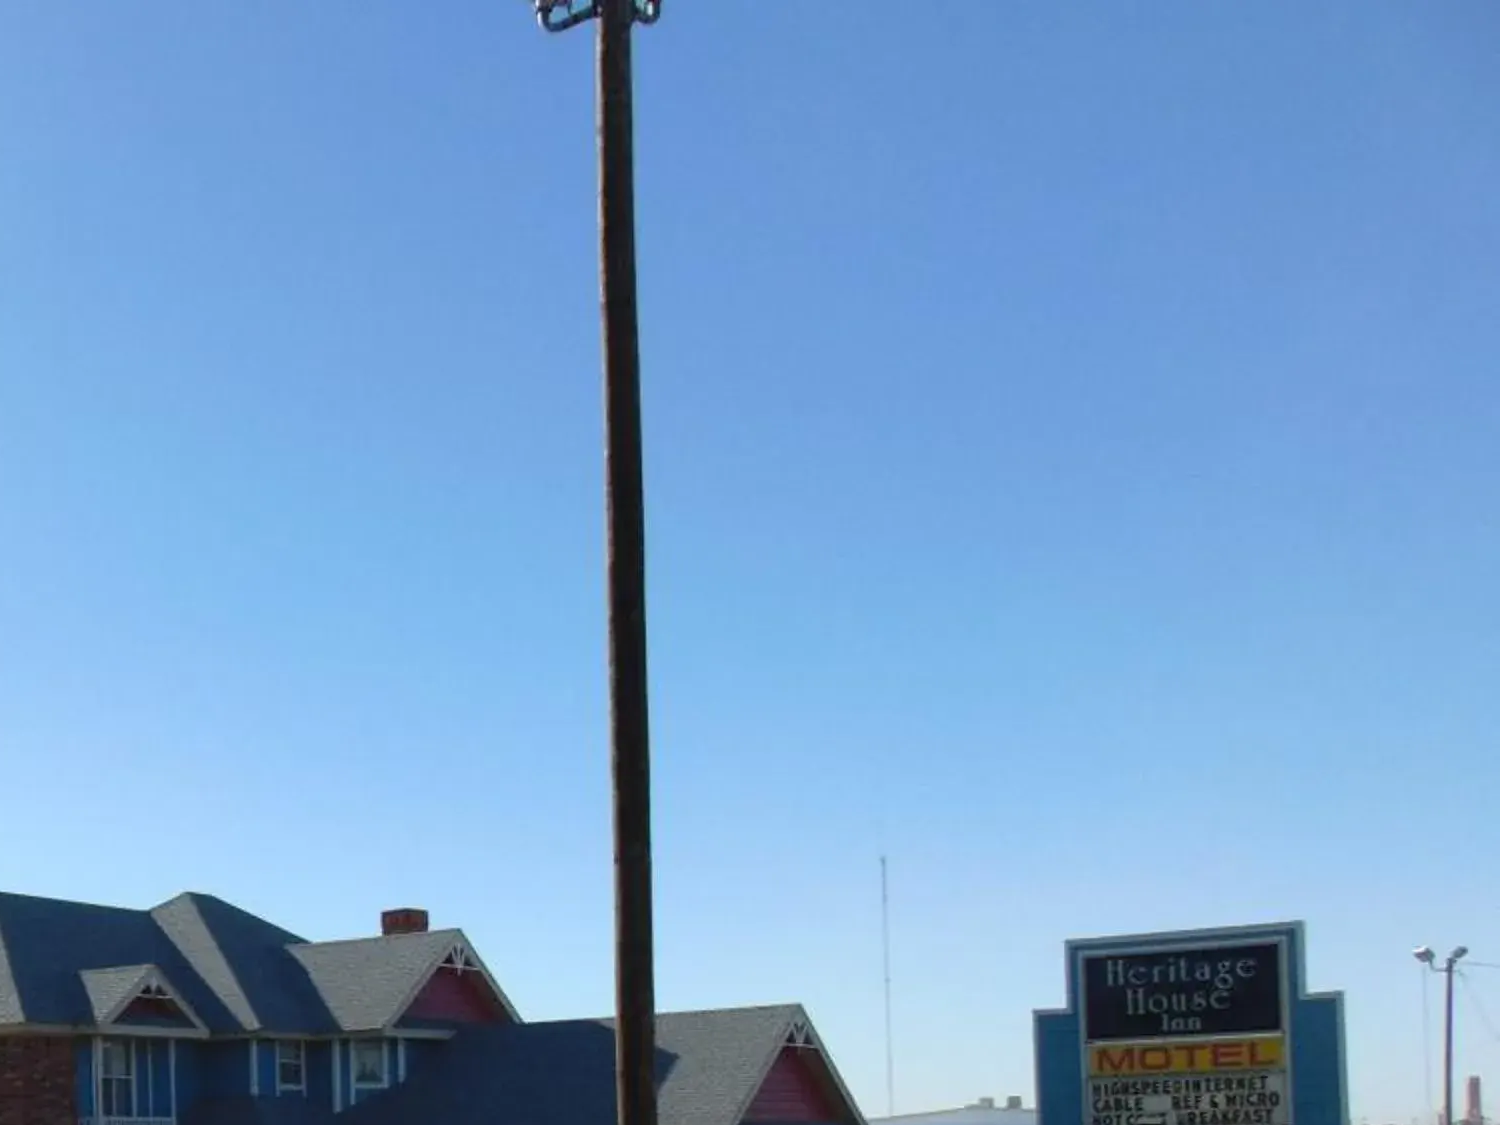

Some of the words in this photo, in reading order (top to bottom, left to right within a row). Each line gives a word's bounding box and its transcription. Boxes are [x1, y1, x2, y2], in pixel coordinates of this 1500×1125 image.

[1107, 955, 1257, 989] Heritage
[1126, 987, 1231, 1015] House
[1161, 1013, 1202, 1032] Inn
[1098, 1041, 1275, 1072] MOTEL
[1093, 1096, 1144, 1113] CABLE
[1172, 1094, 1202, 1110] REF
[1225, 1090, 1280, 1108] MICRO
